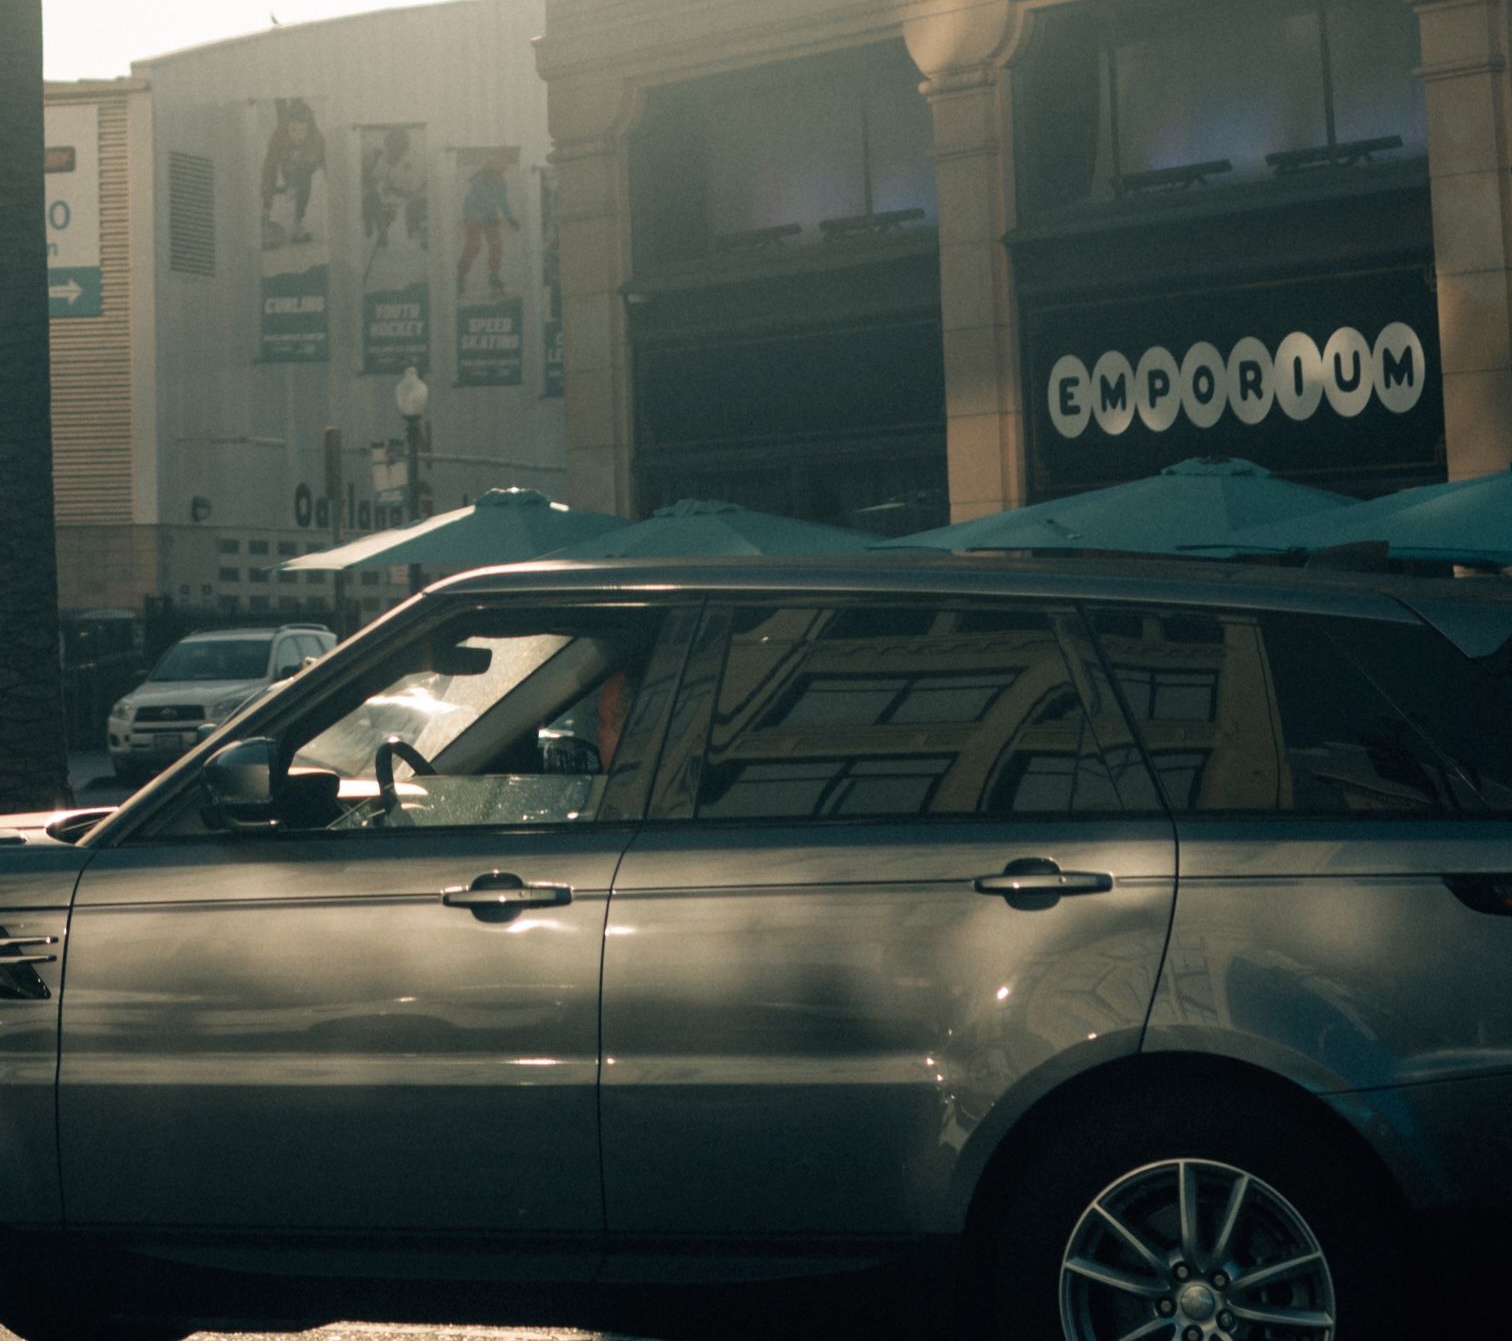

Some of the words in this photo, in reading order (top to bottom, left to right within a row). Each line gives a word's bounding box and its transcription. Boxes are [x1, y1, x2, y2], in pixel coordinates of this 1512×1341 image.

[468, 318, 513, 333] SPEED
[461, 333, 520, 350] SKATING
[1056, 341, 1417, 419] EMPORIUM
